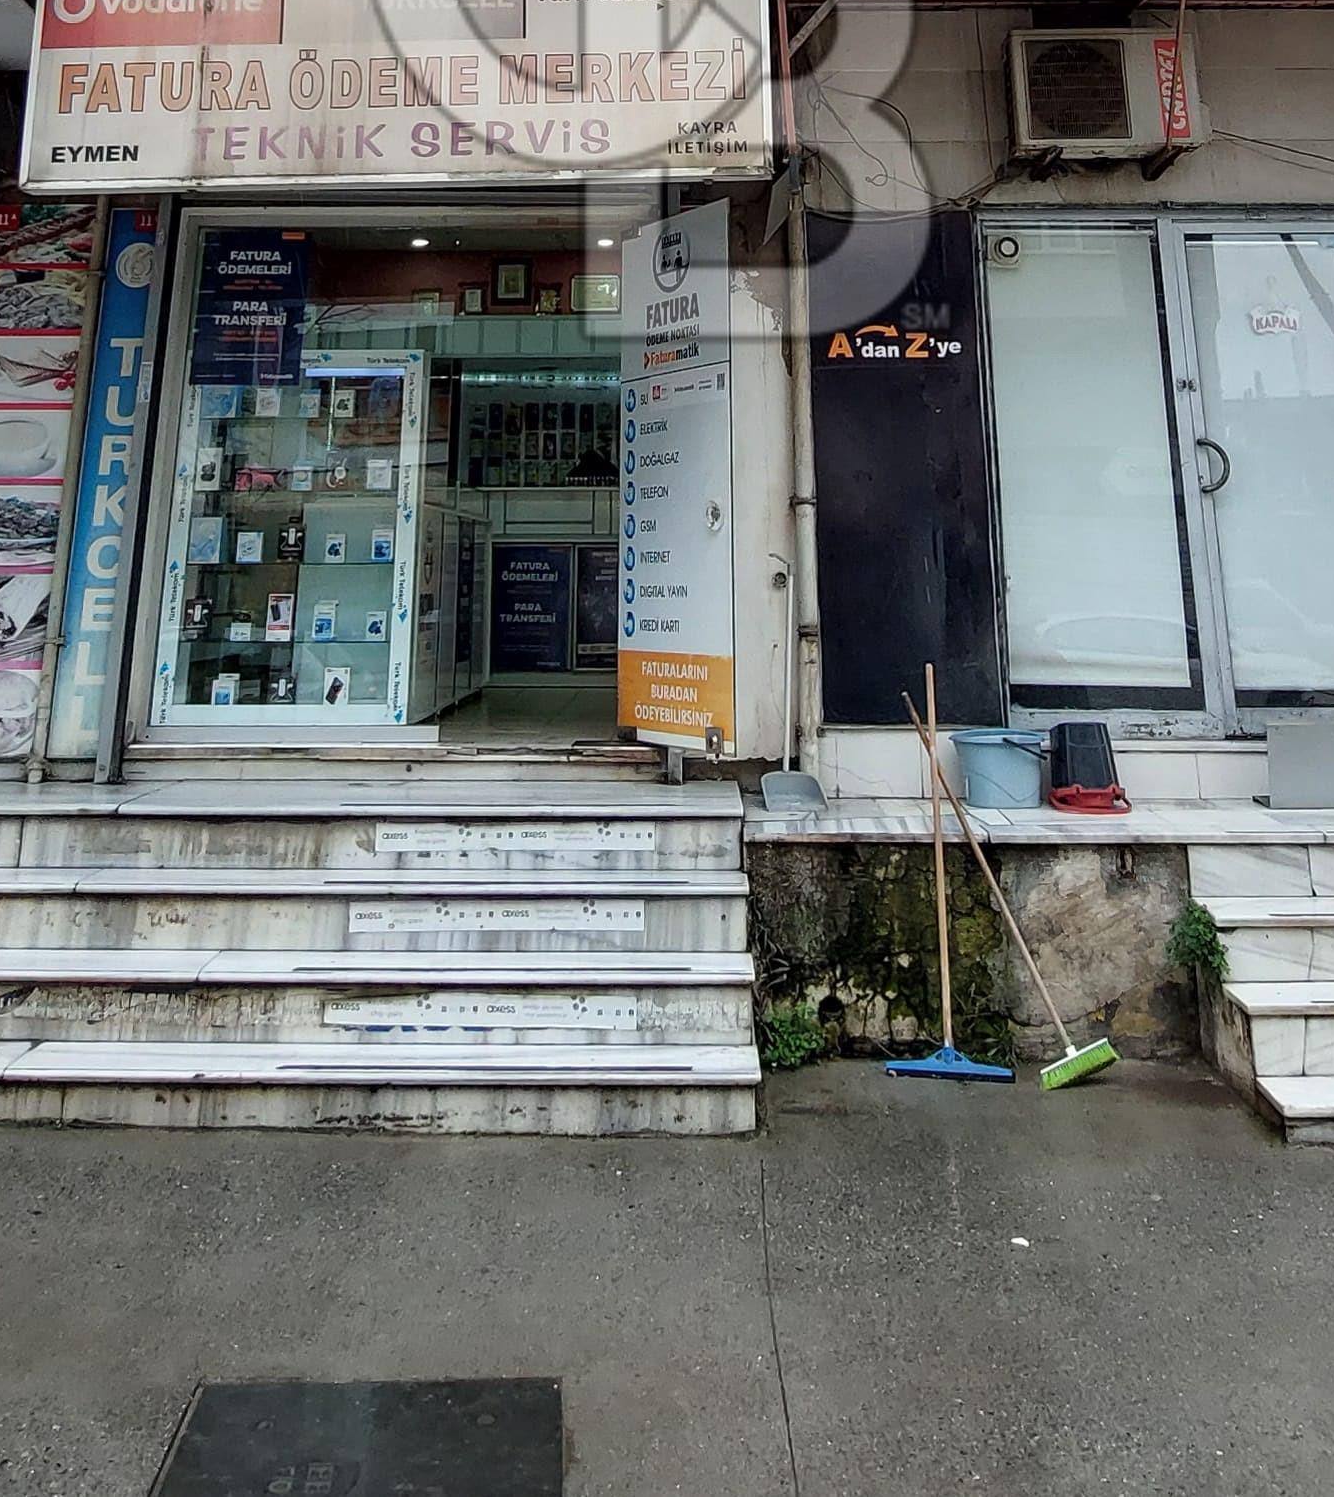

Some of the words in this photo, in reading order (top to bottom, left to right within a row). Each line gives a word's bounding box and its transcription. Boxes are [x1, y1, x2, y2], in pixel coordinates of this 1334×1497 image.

[58, 55, 270, 115] FATURA
[289, 48, 480, 111] ÖDEME
[497, 38, 747, 106] MERKEZİ
[676, 121, 740, 137] KAYRA
[50, 144, 139, 164] EYMEN
[665, 137, 750, 157] İLETİŞİM
[230, 251, 282, 262] FATURA
[218, 262, 292, 275] ÖDEMELERİ
[233, 302, 269, 312] PARA
[646, 292, 700, 331] FATURA
[670, 324, 700, 343] NOKTASI
[650, 343, 700, 368] Faturamatik
[639, 451, 680, 468] DOĞALGAZ
[639, 485, 669, 500] TELEFON
[639, 519, 657, 534] GSM
[510, 562, 551, 571] FATURA
[666, 585, 688, 599] YAYIN
[514, 603, 542, 612] PARA
[660, 619, 681, 634] KARTI
[641, 661, 709, 681] FATURALARINI
[650, 684, 699, 702] BURADAN
